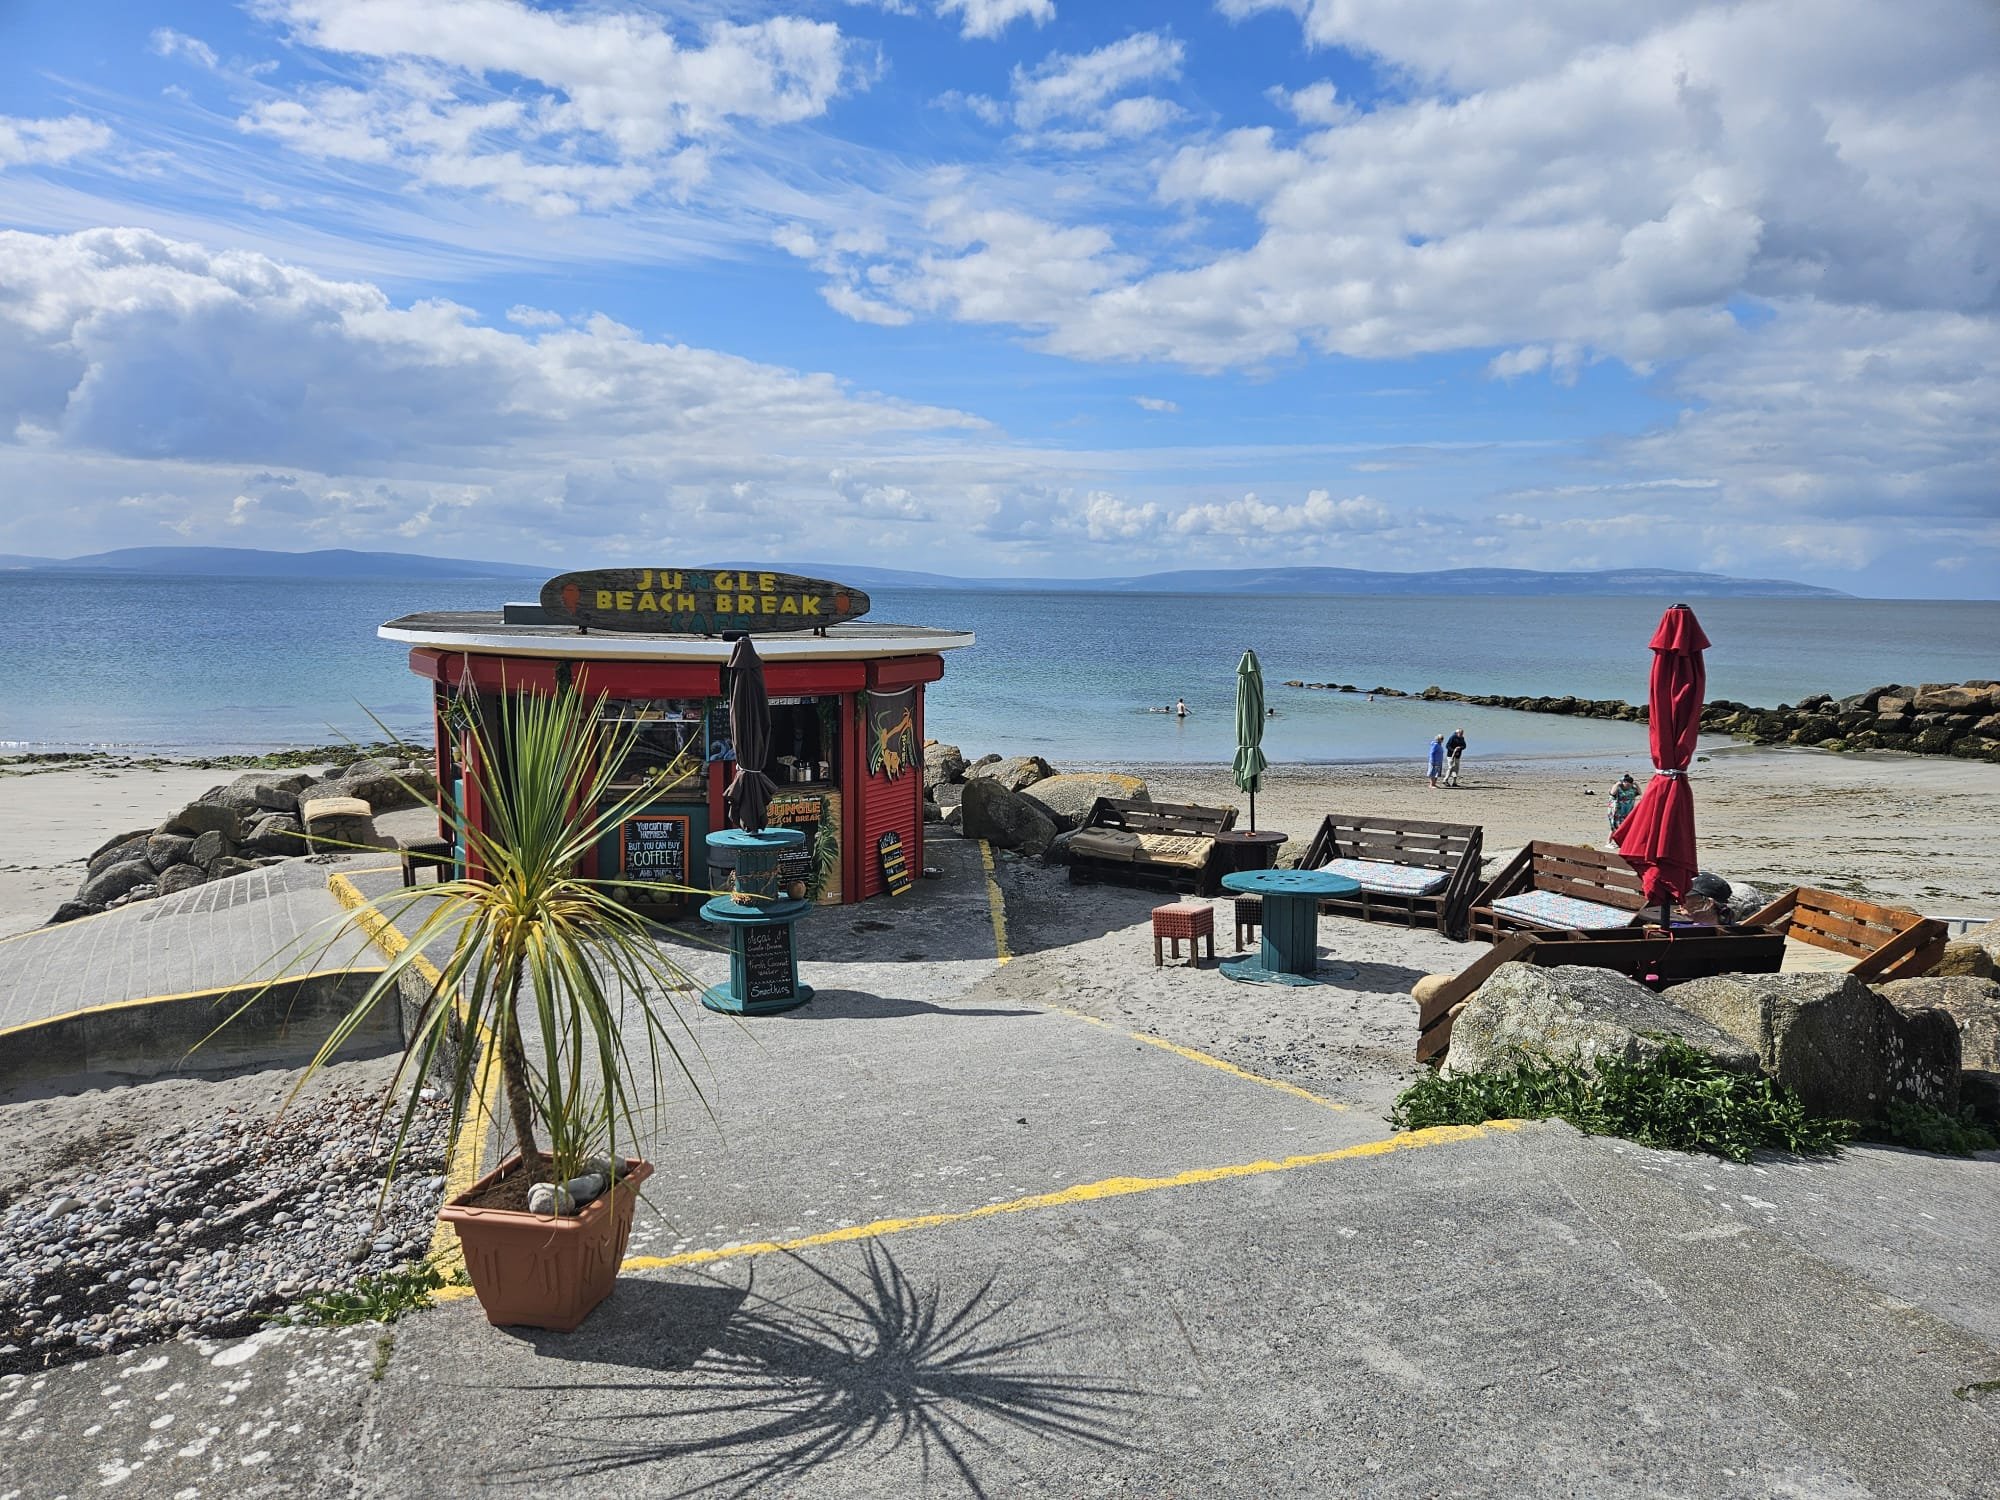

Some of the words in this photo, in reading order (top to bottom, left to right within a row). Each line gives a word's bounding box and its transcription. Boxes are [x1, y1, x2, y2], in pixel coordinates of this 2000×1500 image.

[636, 570, 776, 591] JUNGLE
[596, 591, 696, 612] BEACH
[717, 594, 821, 615] BREAK
[767, 802, 821, 817] JUNGLE
[795, 814, 821, 823] BREAK
[636, 822, 649, 832] YOU
[628, 842, 640, 850] BUT
[643, 842, 655, 850] YOU
[655, 842, 667, 850] CAN
[667, 841, 680, 850] BUY
[634, 850, 677, 866] COFFEE!
